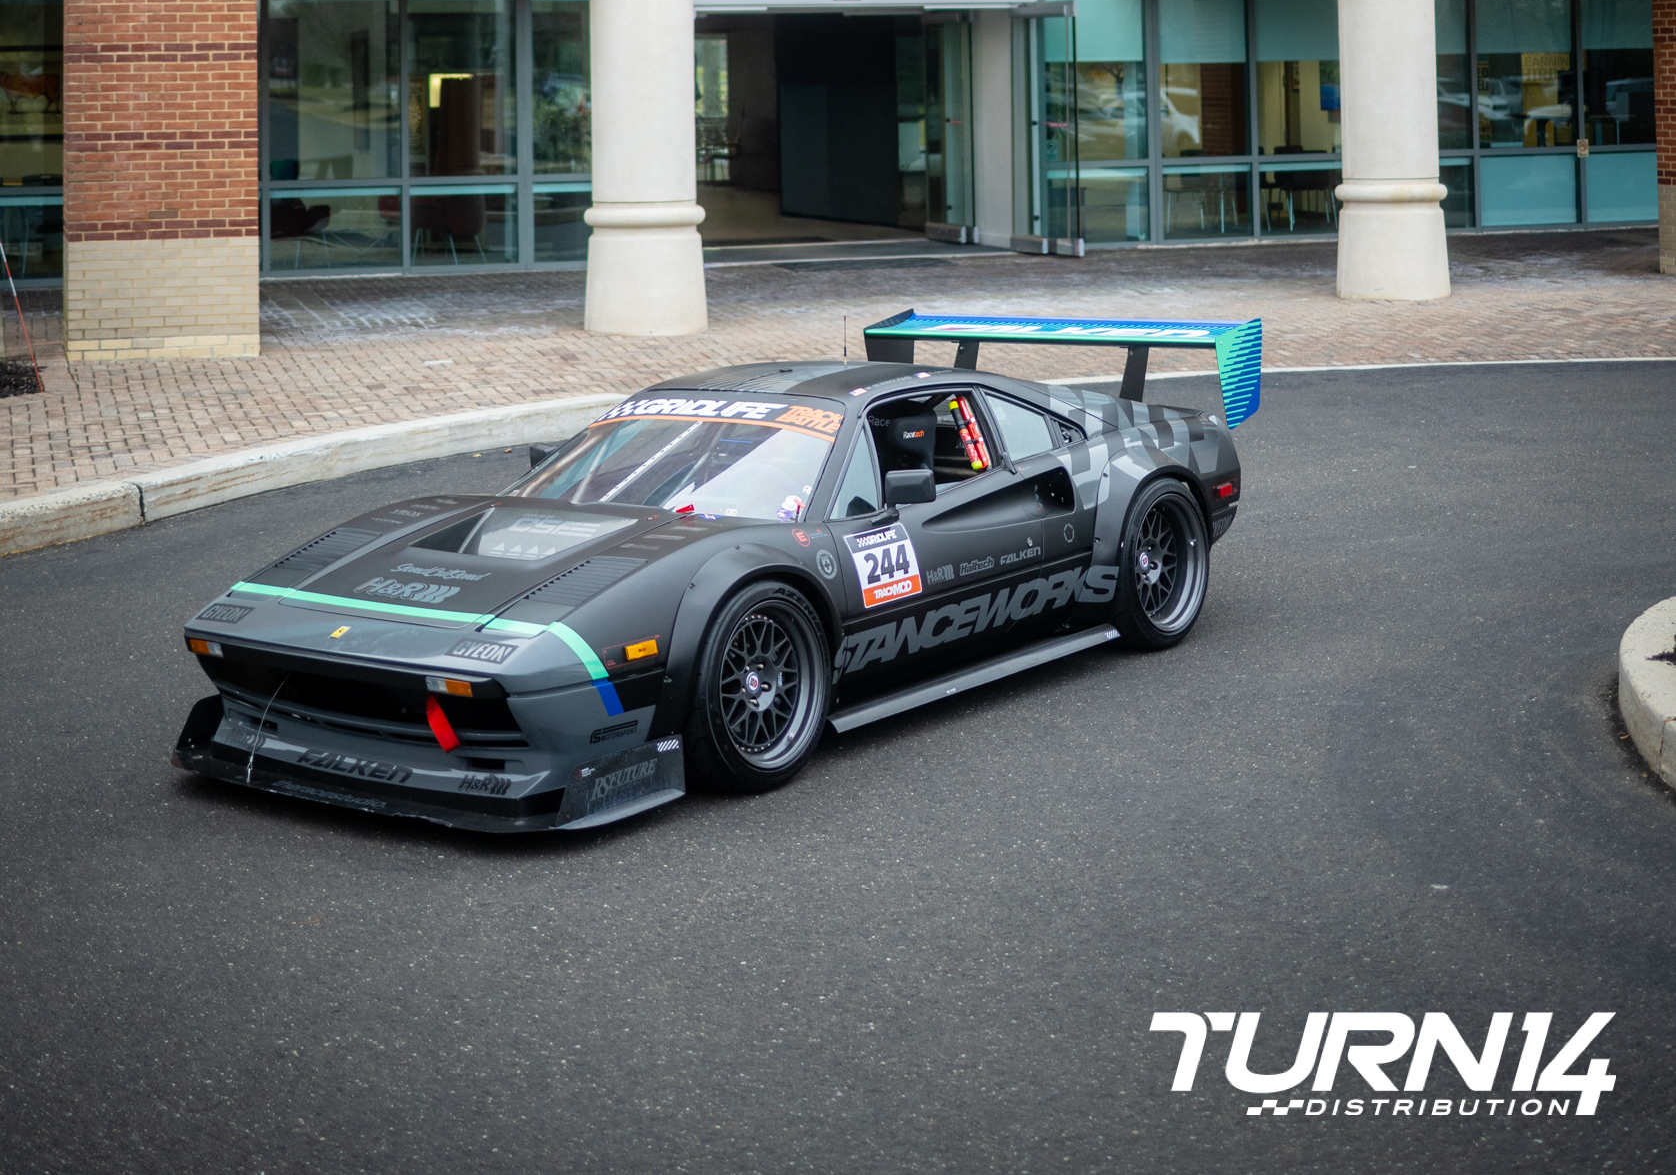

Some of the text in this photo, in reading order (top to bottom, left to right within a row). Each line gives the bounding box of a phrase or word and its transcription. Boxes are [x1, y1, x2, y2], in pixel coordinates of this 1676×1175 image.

[633, 398, 788, 419] GRIDLIFE
[788, 405, 844, 423] TRACK
[775, 413, 841, 433] BATTLE
[903, 429, 925, 439] Racetech
[866, 529, 898, 545] GRIDLIFE
[864, 544, 910, 585] 244
[960, 556, 995, 575] Haltech
[1000, 546, 1041, 565] FALKEN
[354, 576, 442, 601] H&R
[873, 580, 913, 600] TRACKMOD
[202, 605, 250, 622] GYEON
[832, 565, 1119, 685] STANCEWORKS
[453, 640, 513, 662] GYEON
[601, 727, 638, 742] MOTORSPORT
[297, 748, 414, 784] FALKEN
[458, 774, 500, 795] H&R
